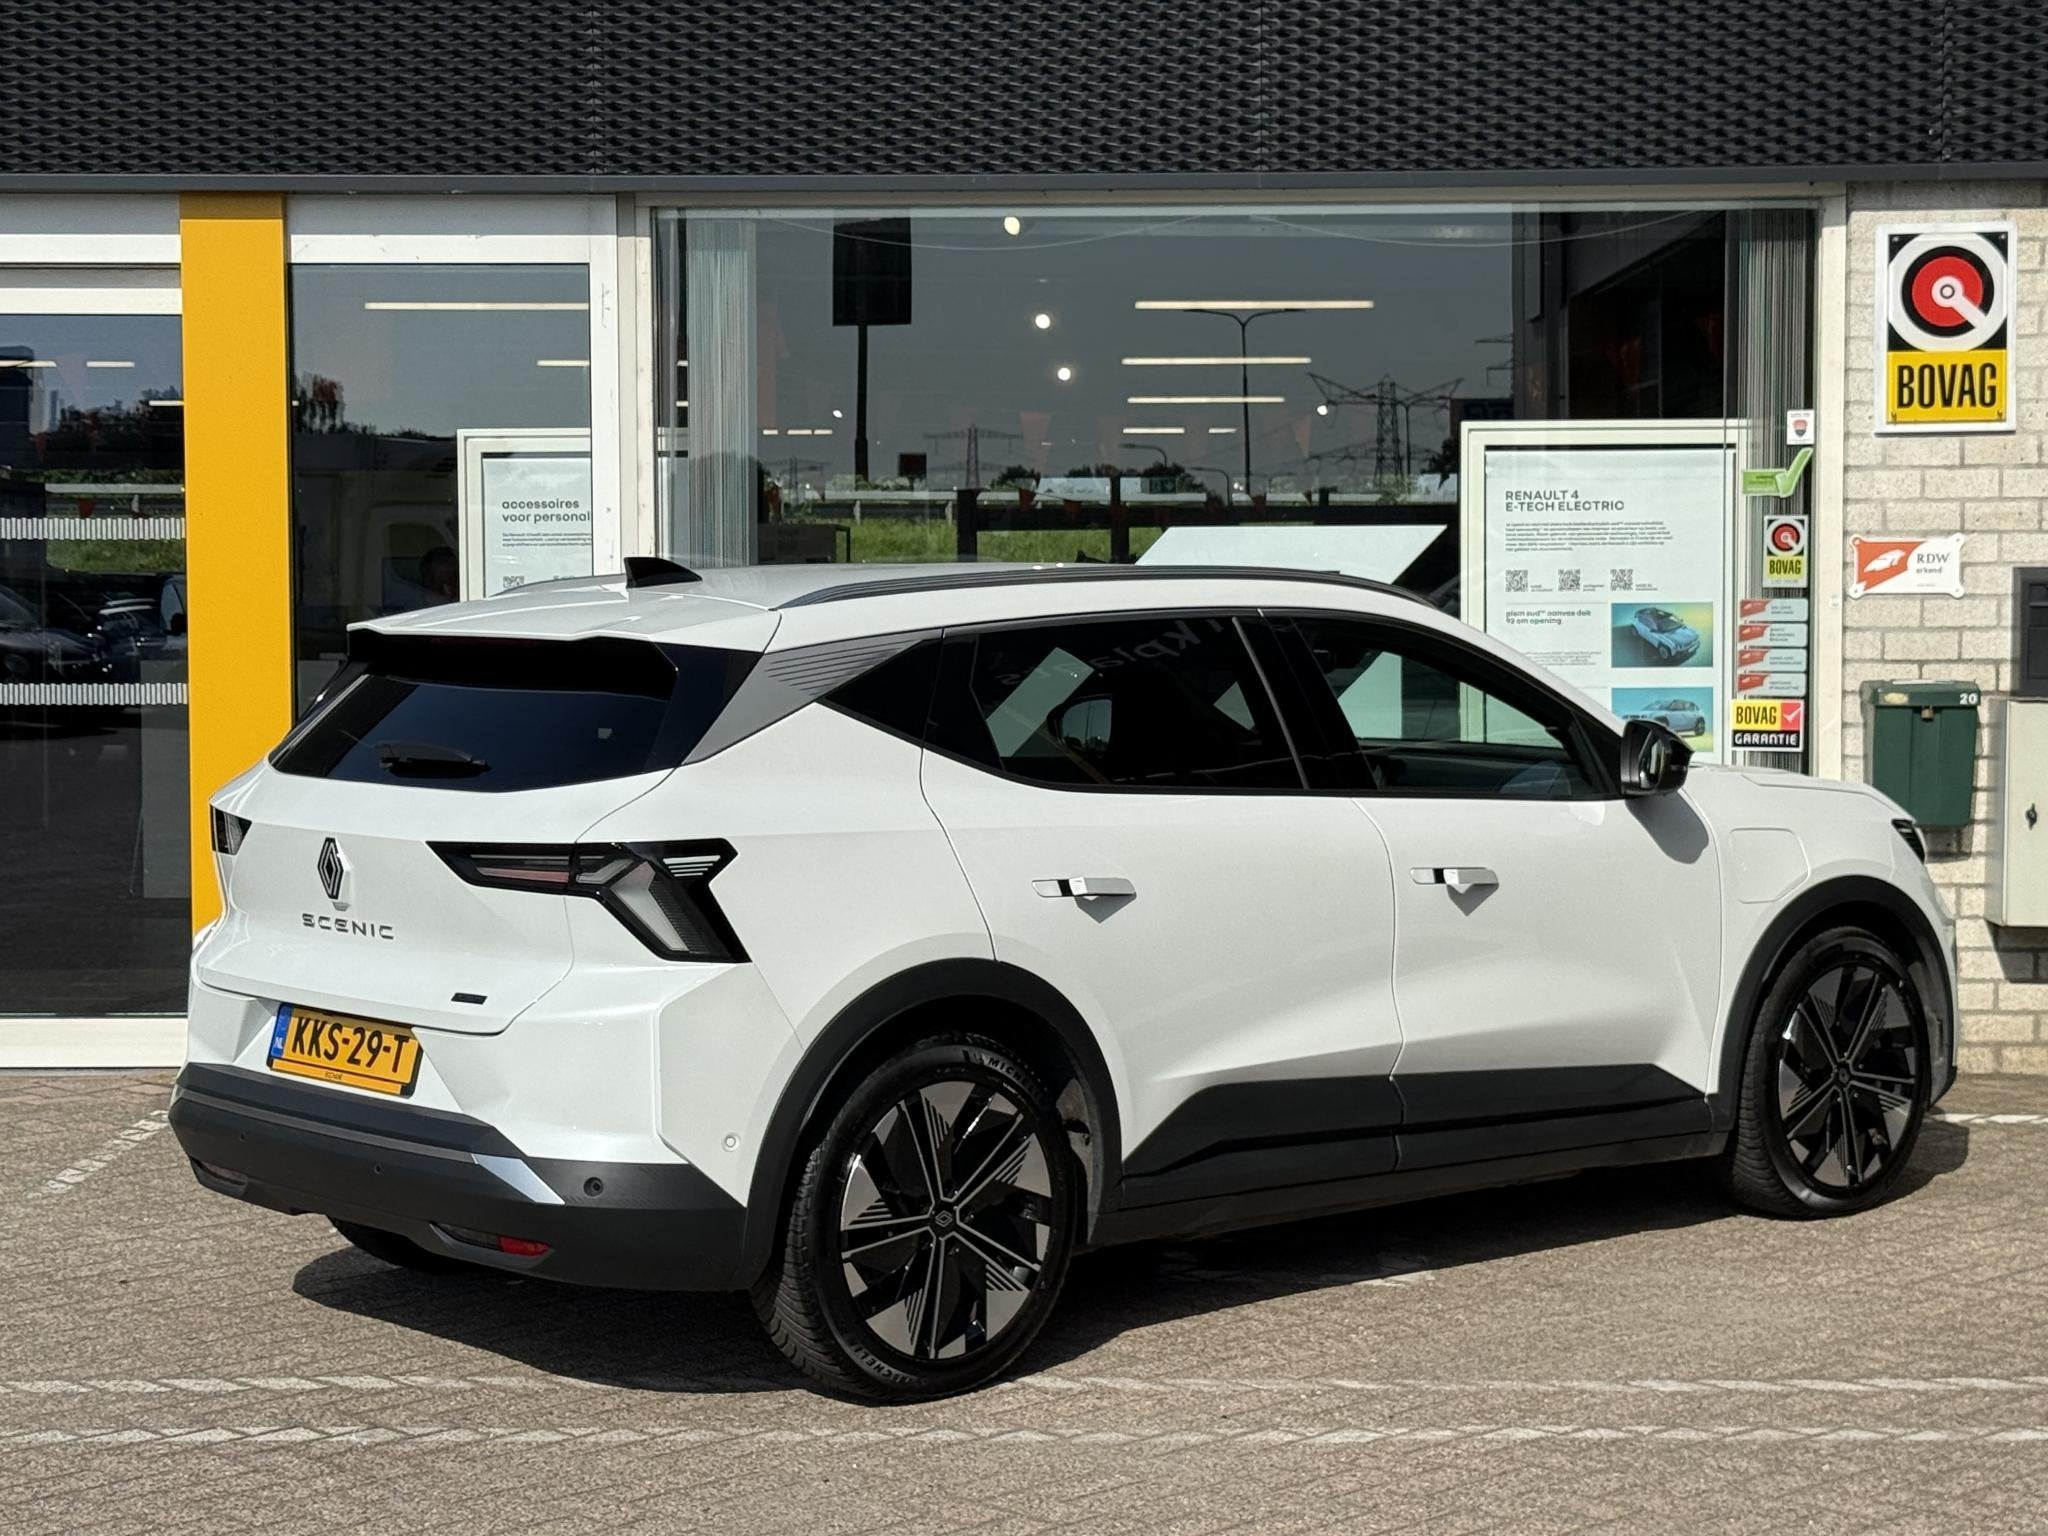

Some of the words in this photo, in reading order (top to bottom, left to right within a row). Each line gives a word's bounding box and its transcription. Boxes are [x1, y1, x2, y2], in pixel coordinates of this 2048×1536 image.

[1897, 362, 1997, 409] BOVAG
[1505, 490, 1568, 501] RENAULT
[1571, 489, 1579, 500] 4
[502, 498, 580, 509] accessoires
[1505, 501, 1555, 512] E-TECH
[1558, 500, 1625, 511] ELECTRIC
[502, 513, 531, 522] voor
[1917, 553, 1950, 564] RDW
[1769, 559, 1801, 575] BOVAG
[1959, 692, 1978, 705] 20
[1736, 706, 1777, 725] BOVAG
[1734, 733, 1799, 746] GARANTIE
[302, 913, 394, 940] SCENIC
[291, 1016, 411, 1074] KKS-29-T
